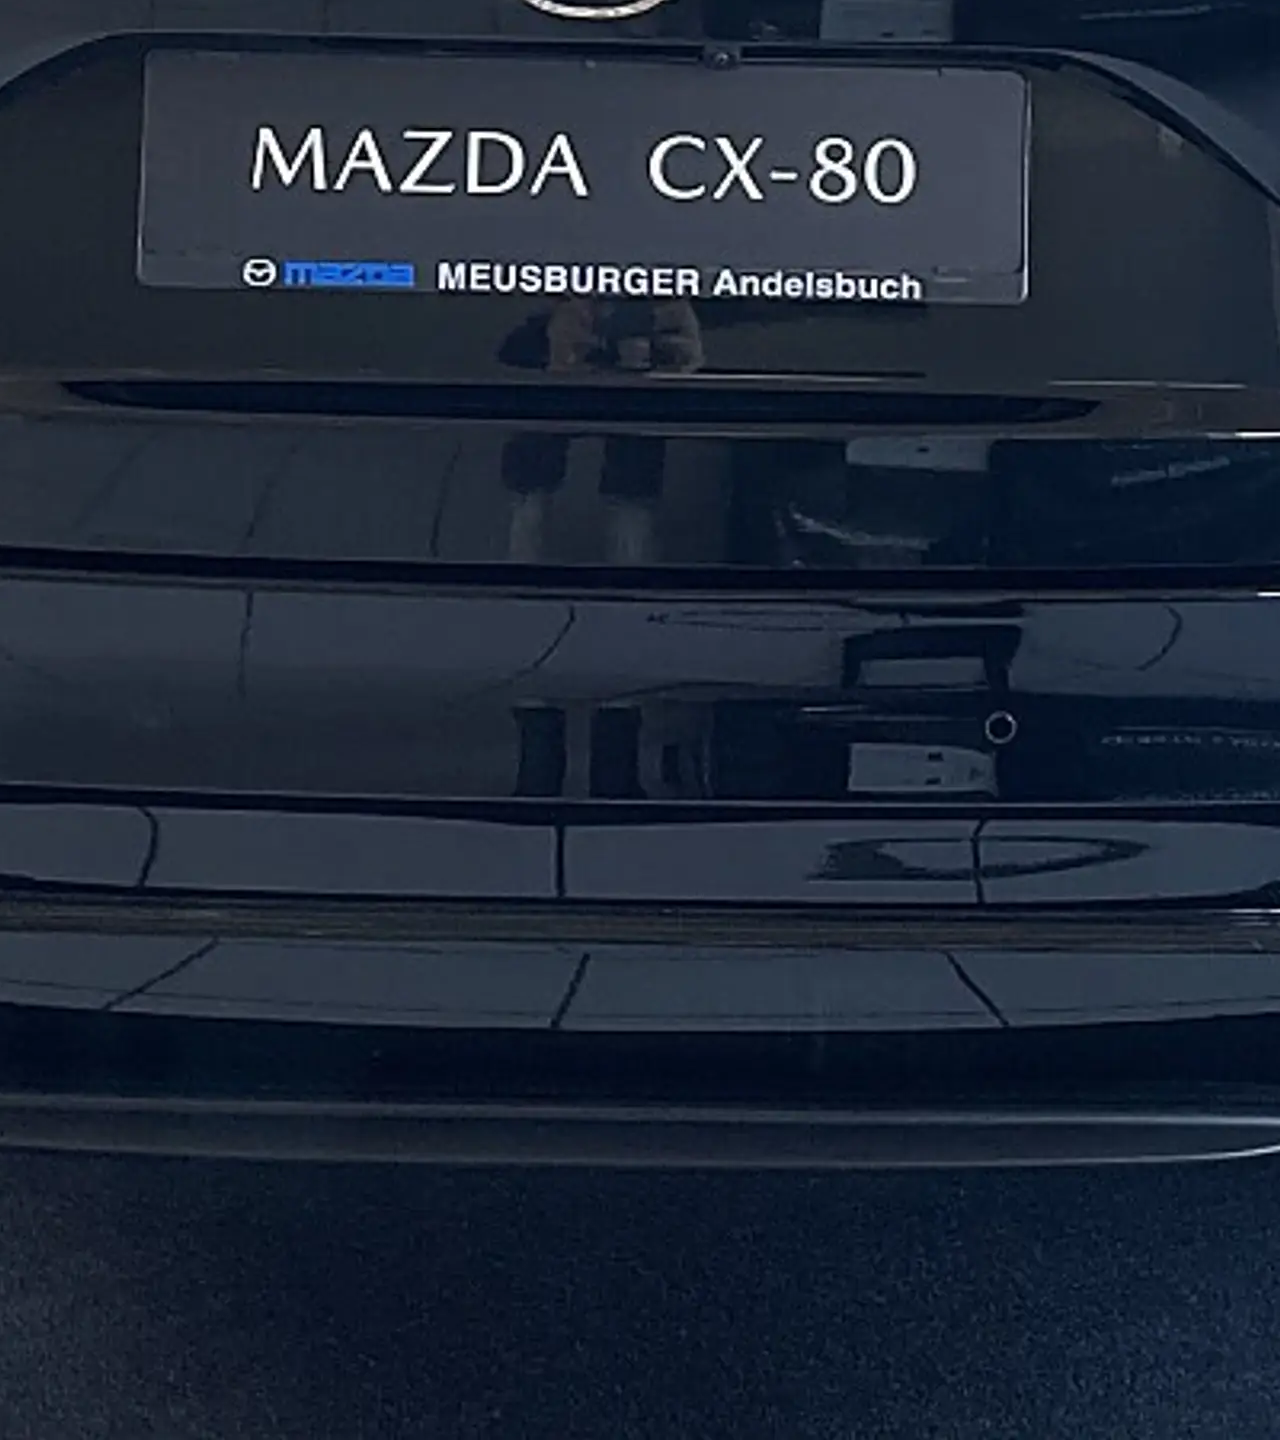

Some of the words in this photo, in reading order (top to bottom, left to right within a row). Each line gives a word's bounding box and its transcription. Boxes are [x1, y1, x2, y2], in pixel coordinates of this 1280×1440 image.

[251, 126, 589, 198] MAZDA
[648, 134, 917, 204] CX-80
[437, 261, 701, 298] MEUSBURGER
[711, 267, 922, 301] Andelsbuch
